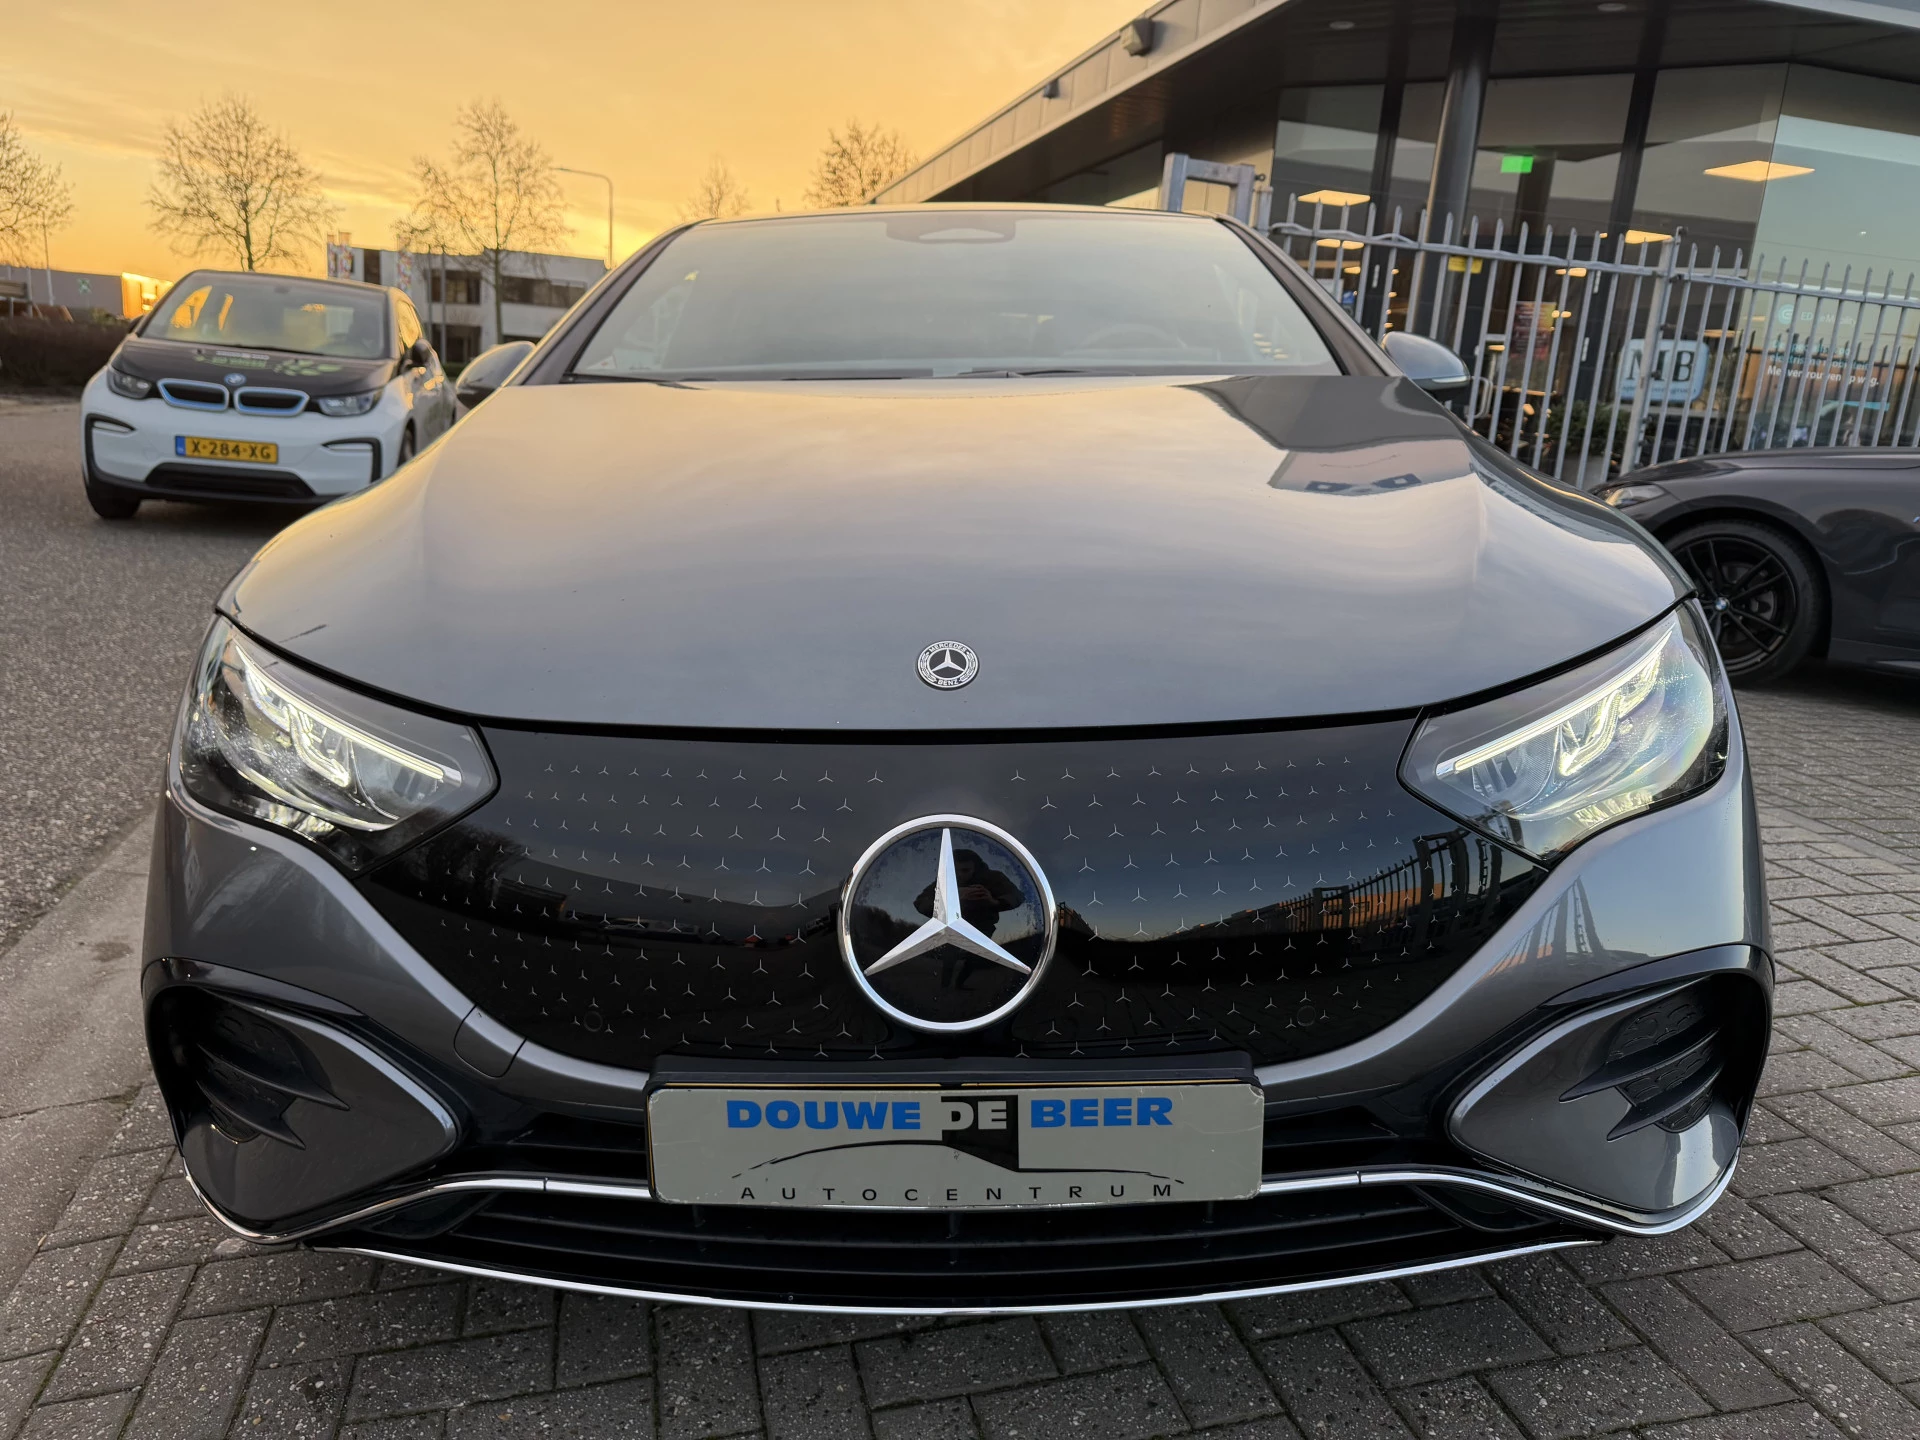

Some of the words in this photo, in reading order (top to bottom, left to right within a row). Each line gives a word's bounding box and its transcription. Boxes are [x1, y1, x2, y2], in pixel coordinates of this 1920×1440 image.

[1767, 365, 1786, 377] Me
[1787, 369, 1842, 382] verrouen
[192, 440, 271, 459] X-284-XG
[928, 642, 967, 653] MERCEDES
[727, 1100, 921, 1130] DOUWE
[942, 1101, 1007, 1131] DE
[1031, 1097, 1173, 1128] BEER
[741, 1185, 1171, 1201] AUTOCENTRUM
